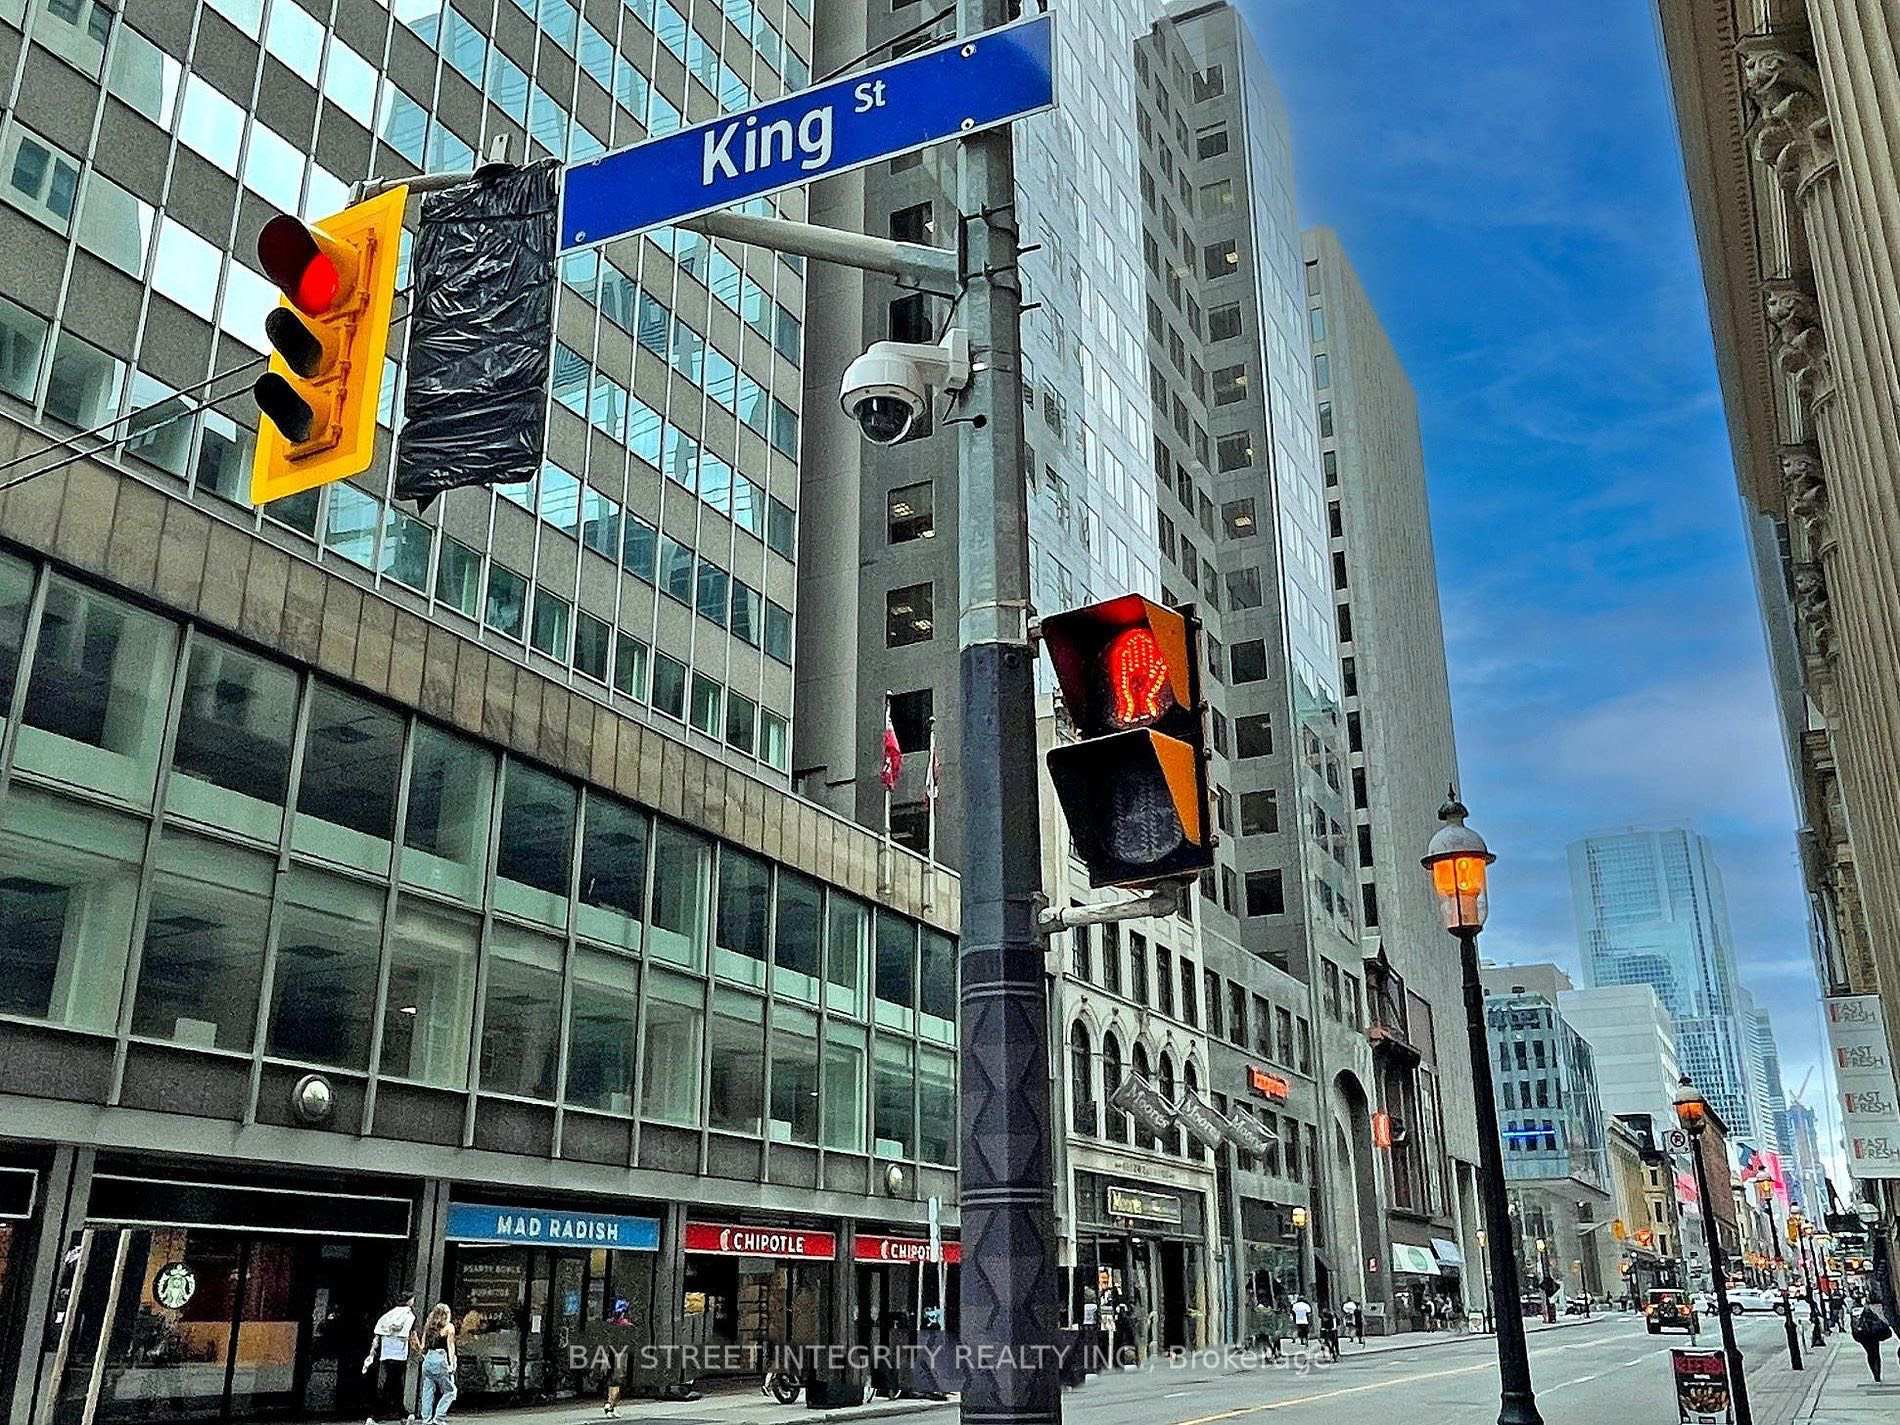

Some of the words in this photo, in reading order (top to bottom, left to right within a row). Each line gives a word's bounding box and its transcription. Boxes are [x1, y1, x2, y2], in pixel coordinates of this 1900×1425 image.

[703, 105, 833, 185] King
[854, 80, 887, 113] St
[496, 1215, 542, 1237] MAD
[549, 1218, 619, 1241] RADISH
[733, 1231, 805, 1253] CHIPOTLE
[890, 1243, 944, 1260] CHIPOT
